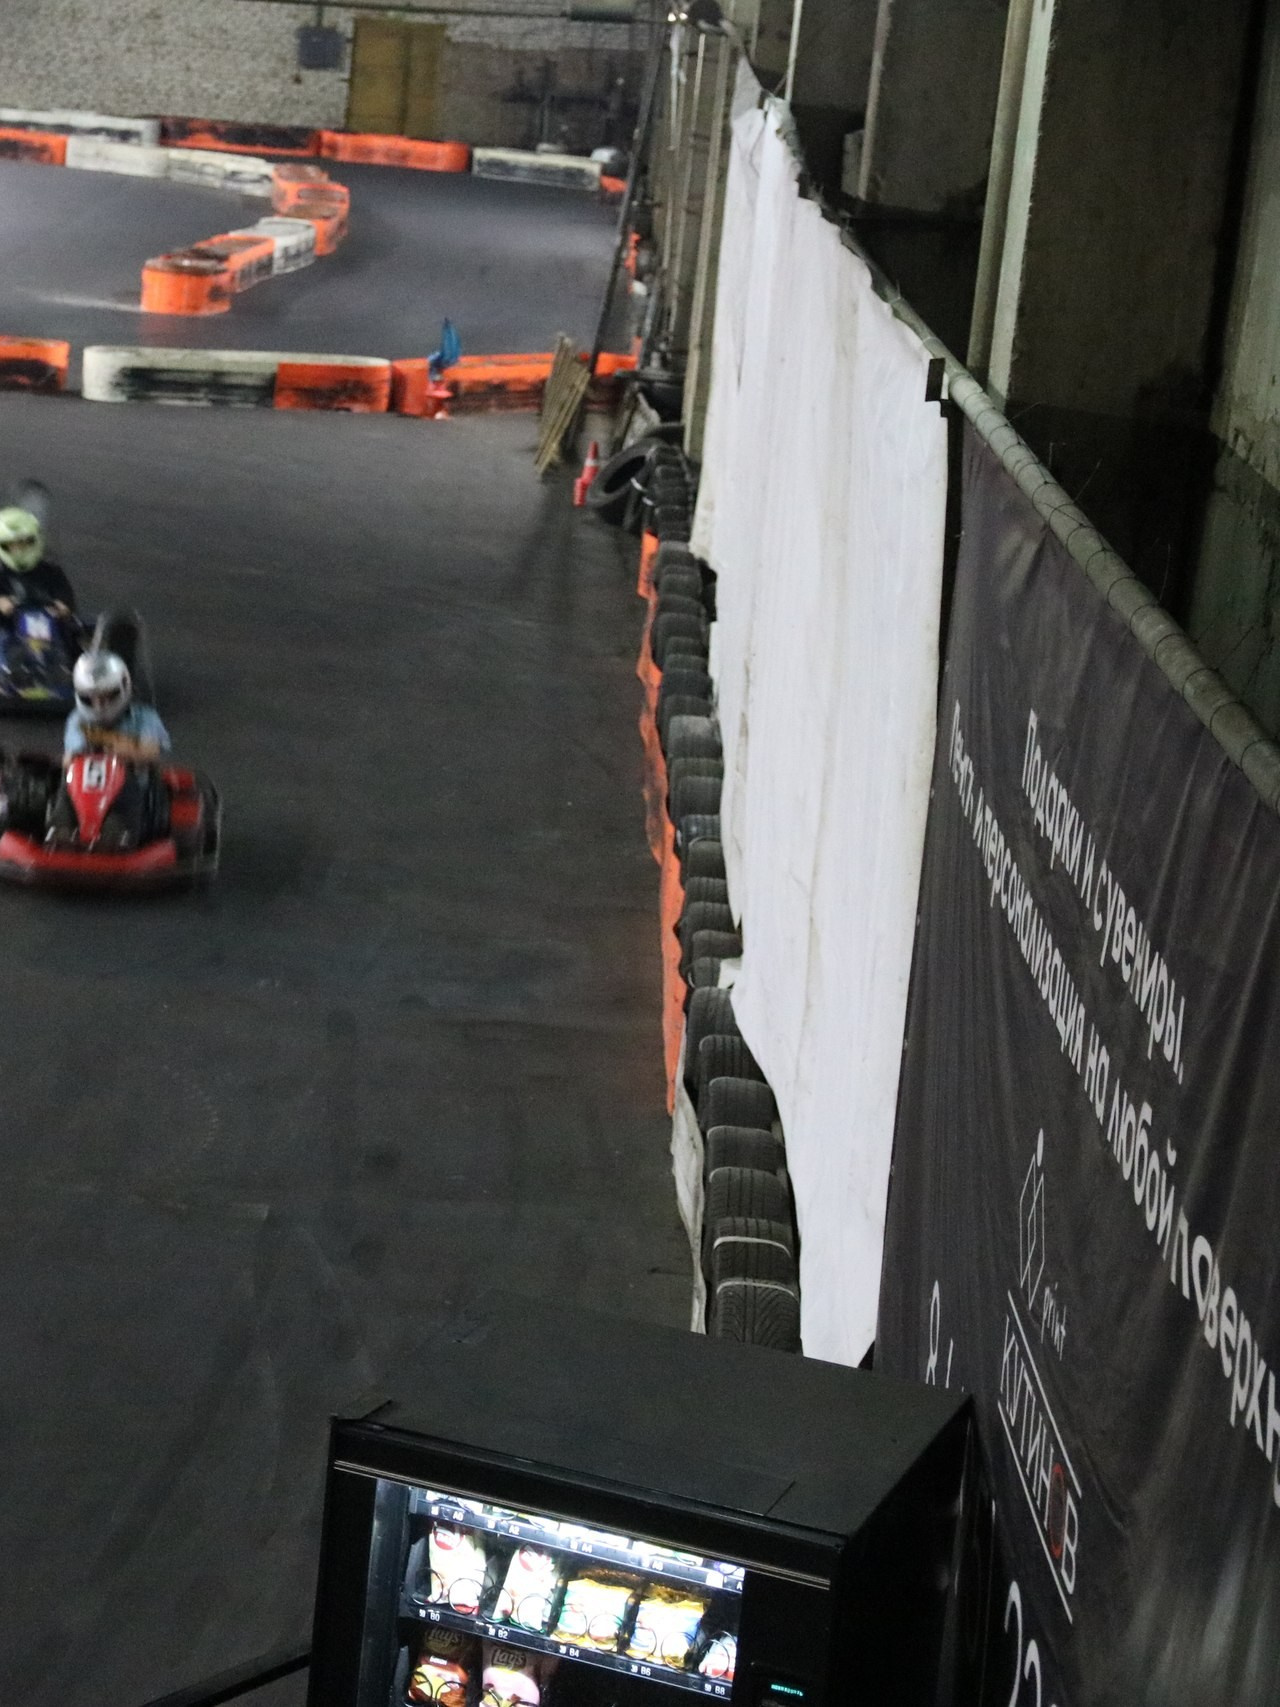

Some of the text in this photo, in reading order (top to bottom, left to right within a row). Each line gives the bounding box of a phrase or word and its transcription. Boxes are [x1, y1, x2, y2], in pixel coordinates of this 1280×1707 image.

[1022, 708, 1084, 886] Подарки
[1080, 833, 1096, 910] и
[982, 803, 1086, 1076] персонализация
[1084, 1023, 1110, 1126] на
[1107, 1078, 1177, 1262] любой
[1000, 1313, 1079, 1595] КУТИНОВ
